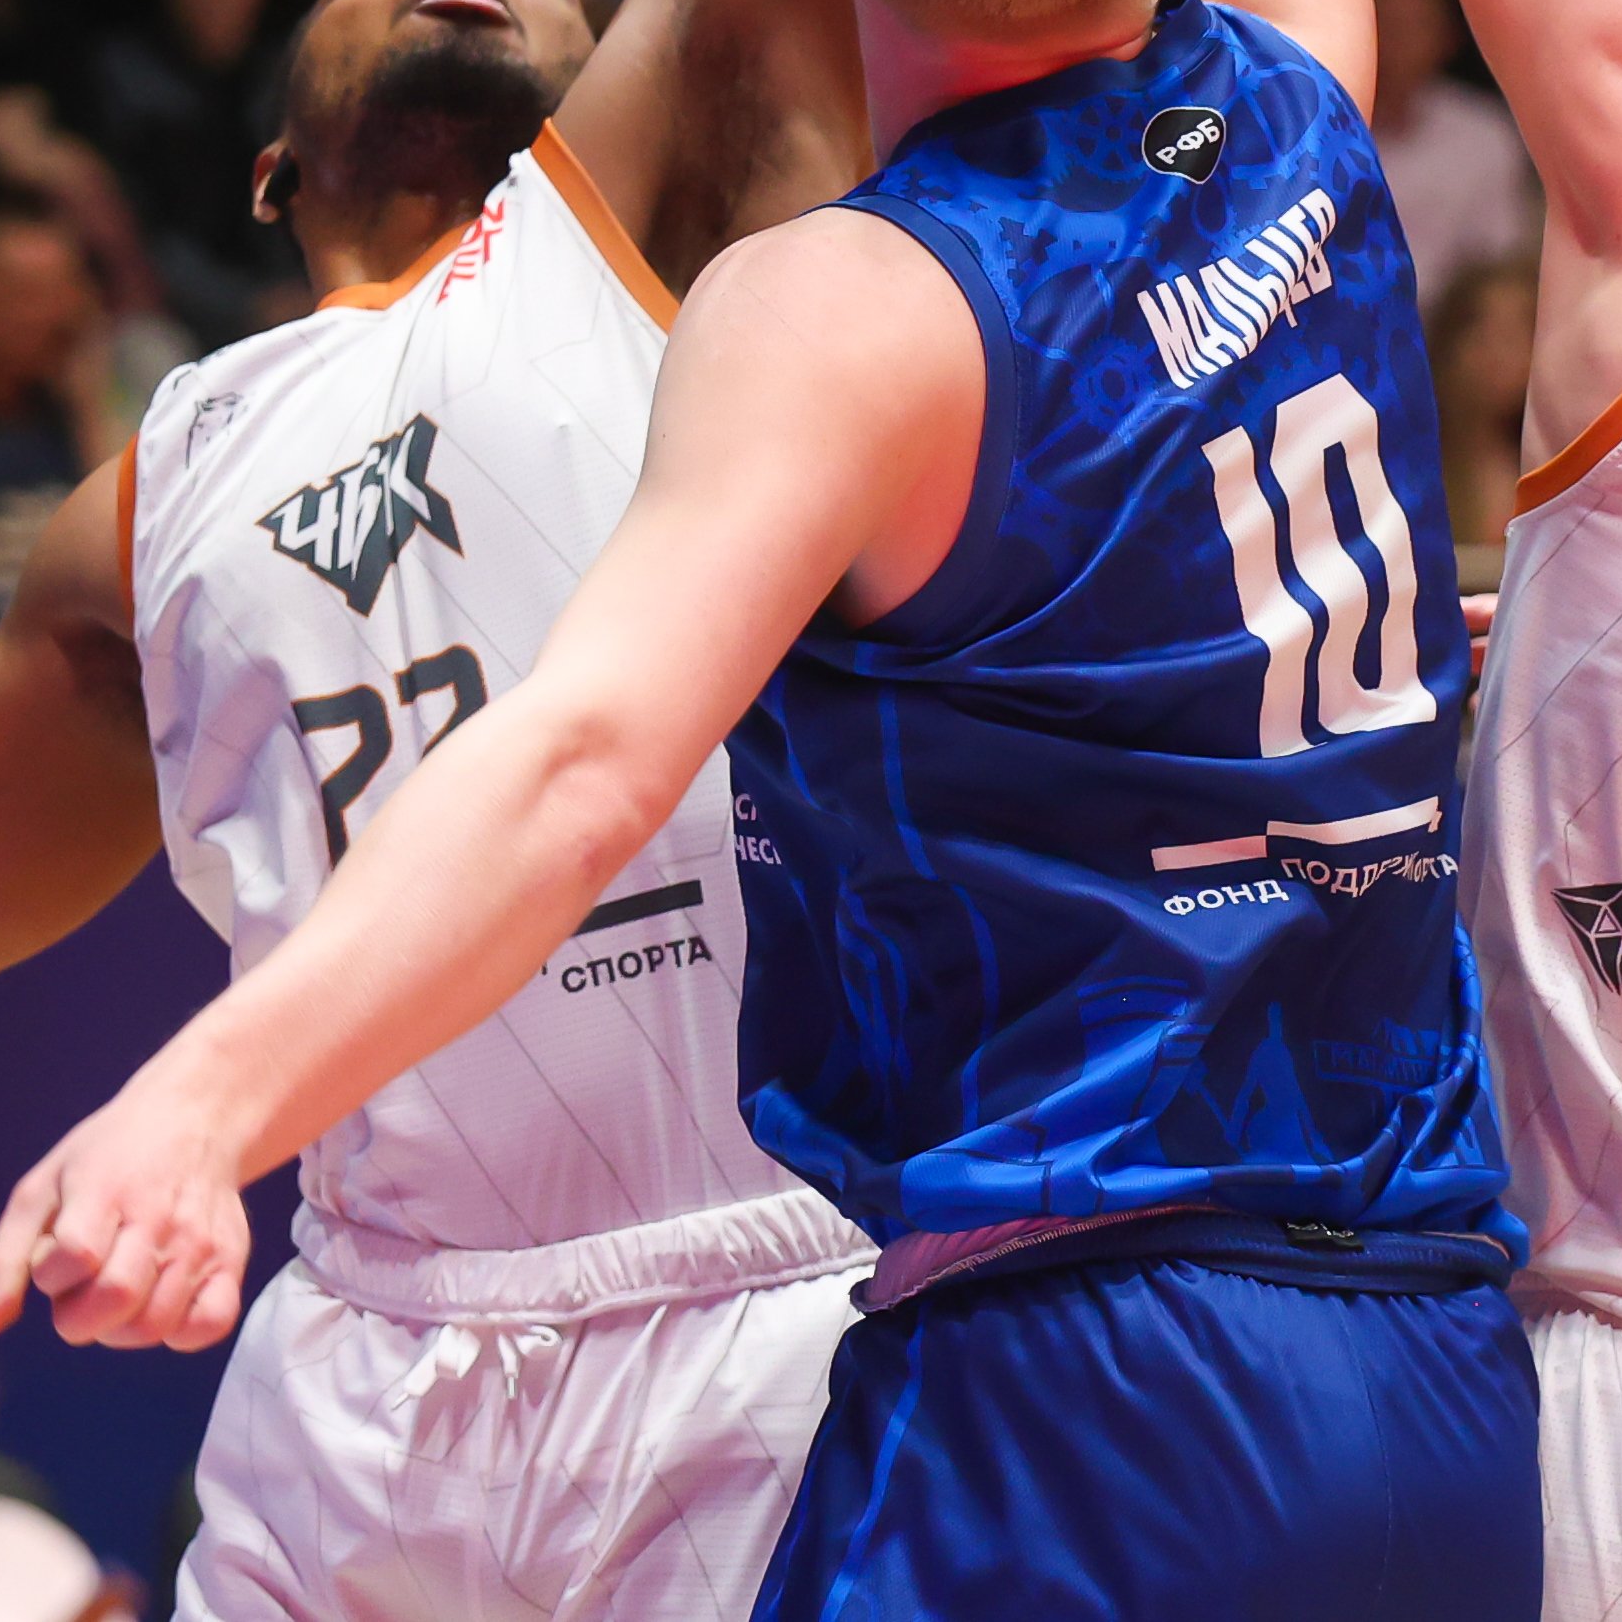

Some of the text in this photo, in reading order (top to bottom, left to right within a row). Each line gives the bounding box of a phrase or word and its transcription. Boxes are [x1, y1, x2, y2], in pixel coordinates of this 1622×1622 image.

[1156, 117, 1221, 165] РФБ
[1200, 372, 1437, 759] 10
[1163, 879, 1290, 916] ФОНД
[561, 934, 713, 994] СПОРТА
